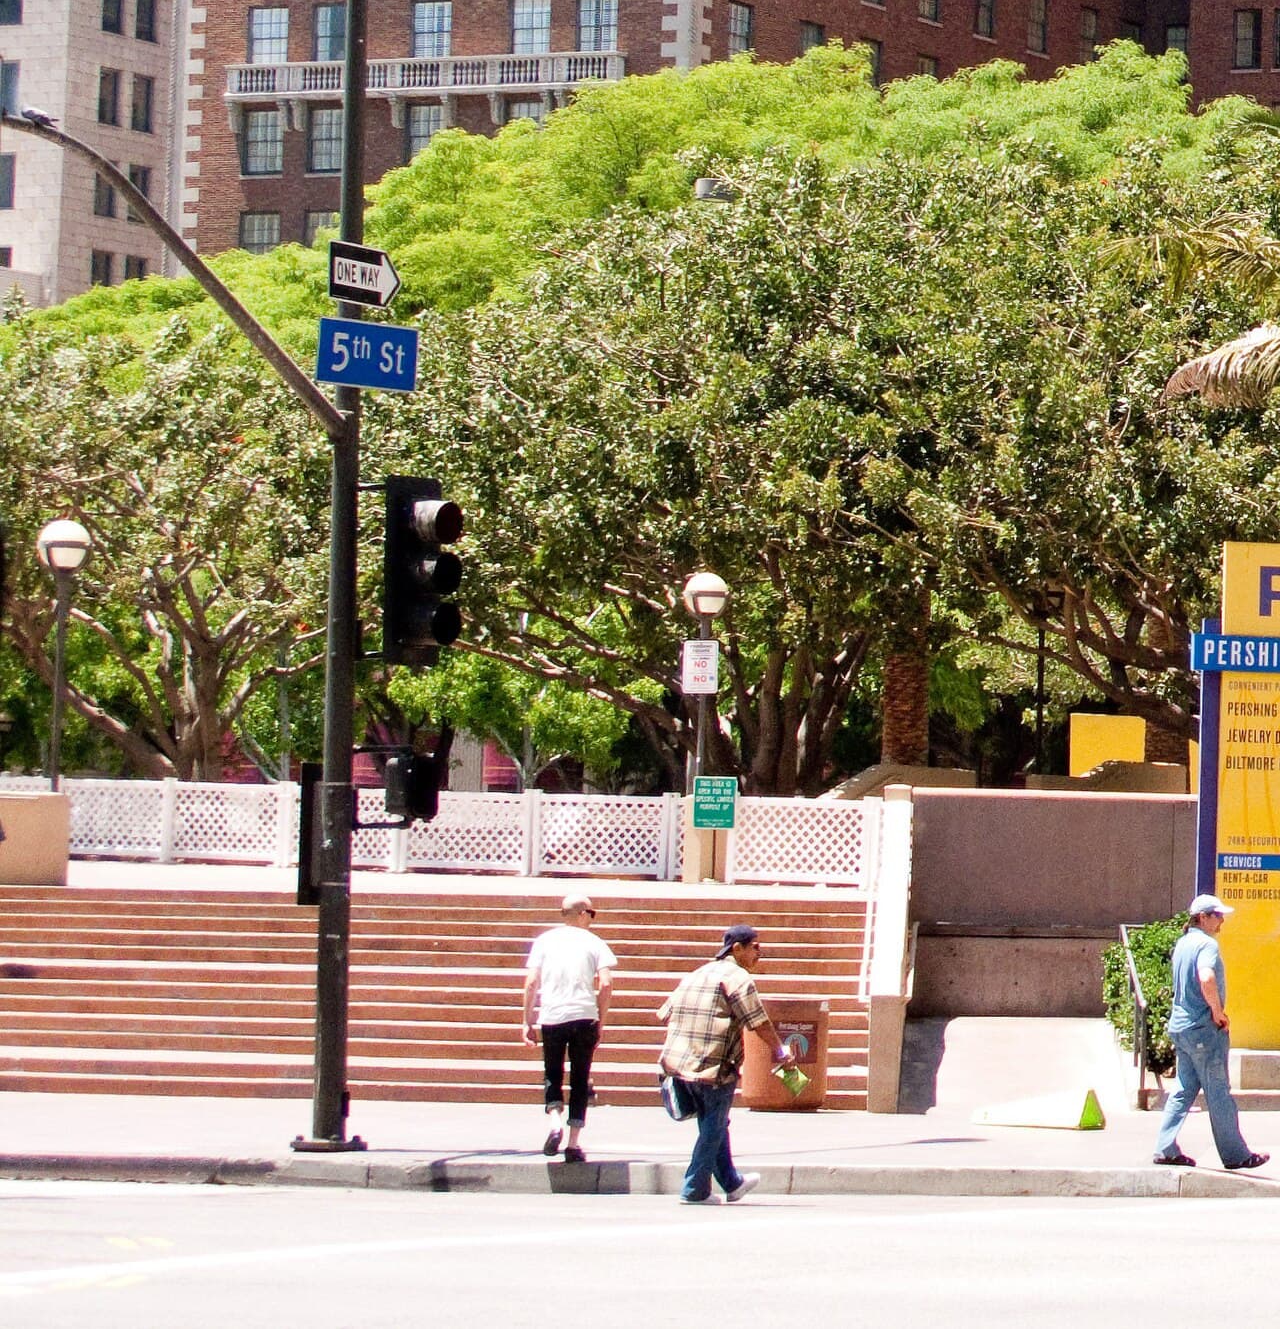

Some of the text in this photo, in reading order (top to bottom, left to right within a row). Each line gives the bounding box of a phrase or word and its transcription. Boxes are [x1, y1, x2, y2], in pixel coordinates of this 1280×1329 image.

[337, 261, 380, 288] ONE WAY
[331, 332, 405, 374] 5th St
[694, 660, 707, 668] NO
[1228, 680, 1272, 691] CONVENIENT
[1227, 701, 1278, 717] PERSHING
[1226, 728, 1271, 743] JEWELRY
[1225, 755, 1275, 770] BILTMORE
[1248, 836, 1280, 846] SECURITY
[1223, 856, 1262, 868] SERVICES
[1223, 872, 1268, 884] RENT-A-CAR
[1223, 888, 1244, 899] FOOD
